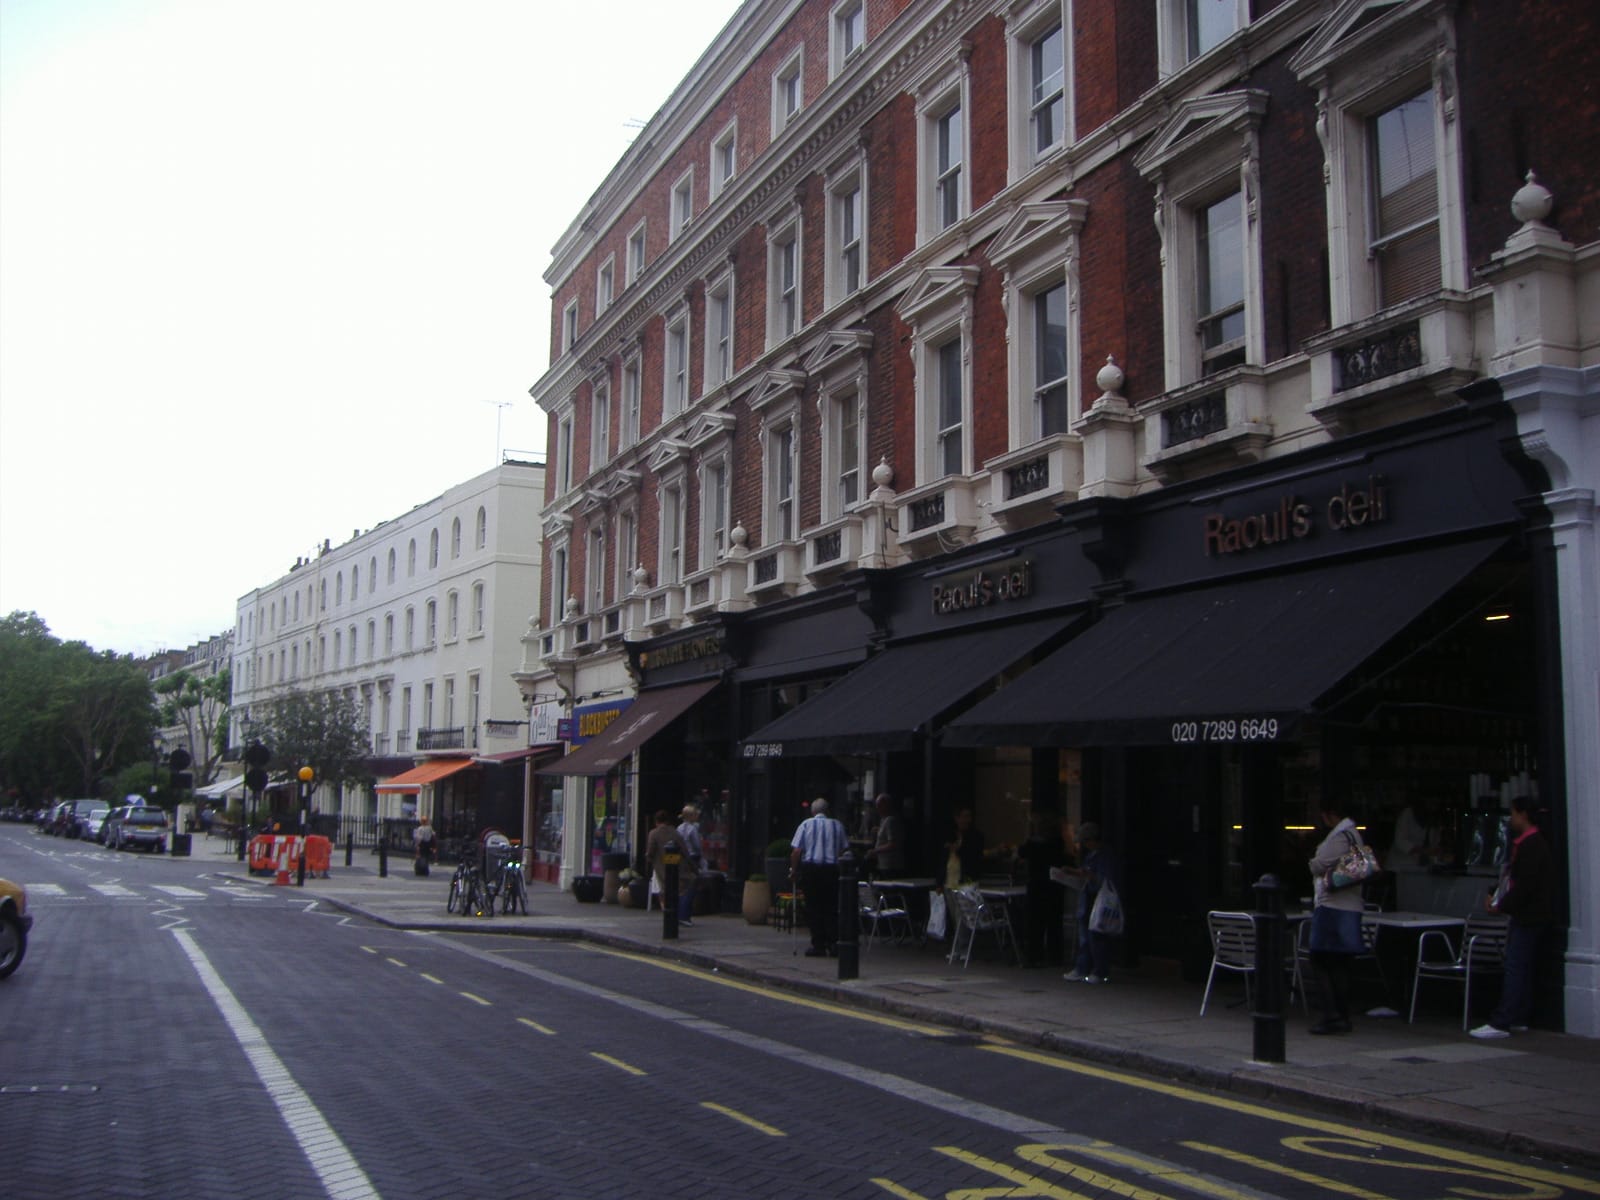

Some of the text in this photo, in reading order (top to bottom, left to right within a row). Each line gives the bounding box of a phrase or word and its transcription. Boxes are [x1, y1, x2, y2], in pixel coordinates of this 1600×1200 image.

[1204, 474, 1385, 556] Raoul's deli
[932, 560, 1030, 615] Raoul's deli
[1171, 718, 1278, 742] 020 7289 6649
